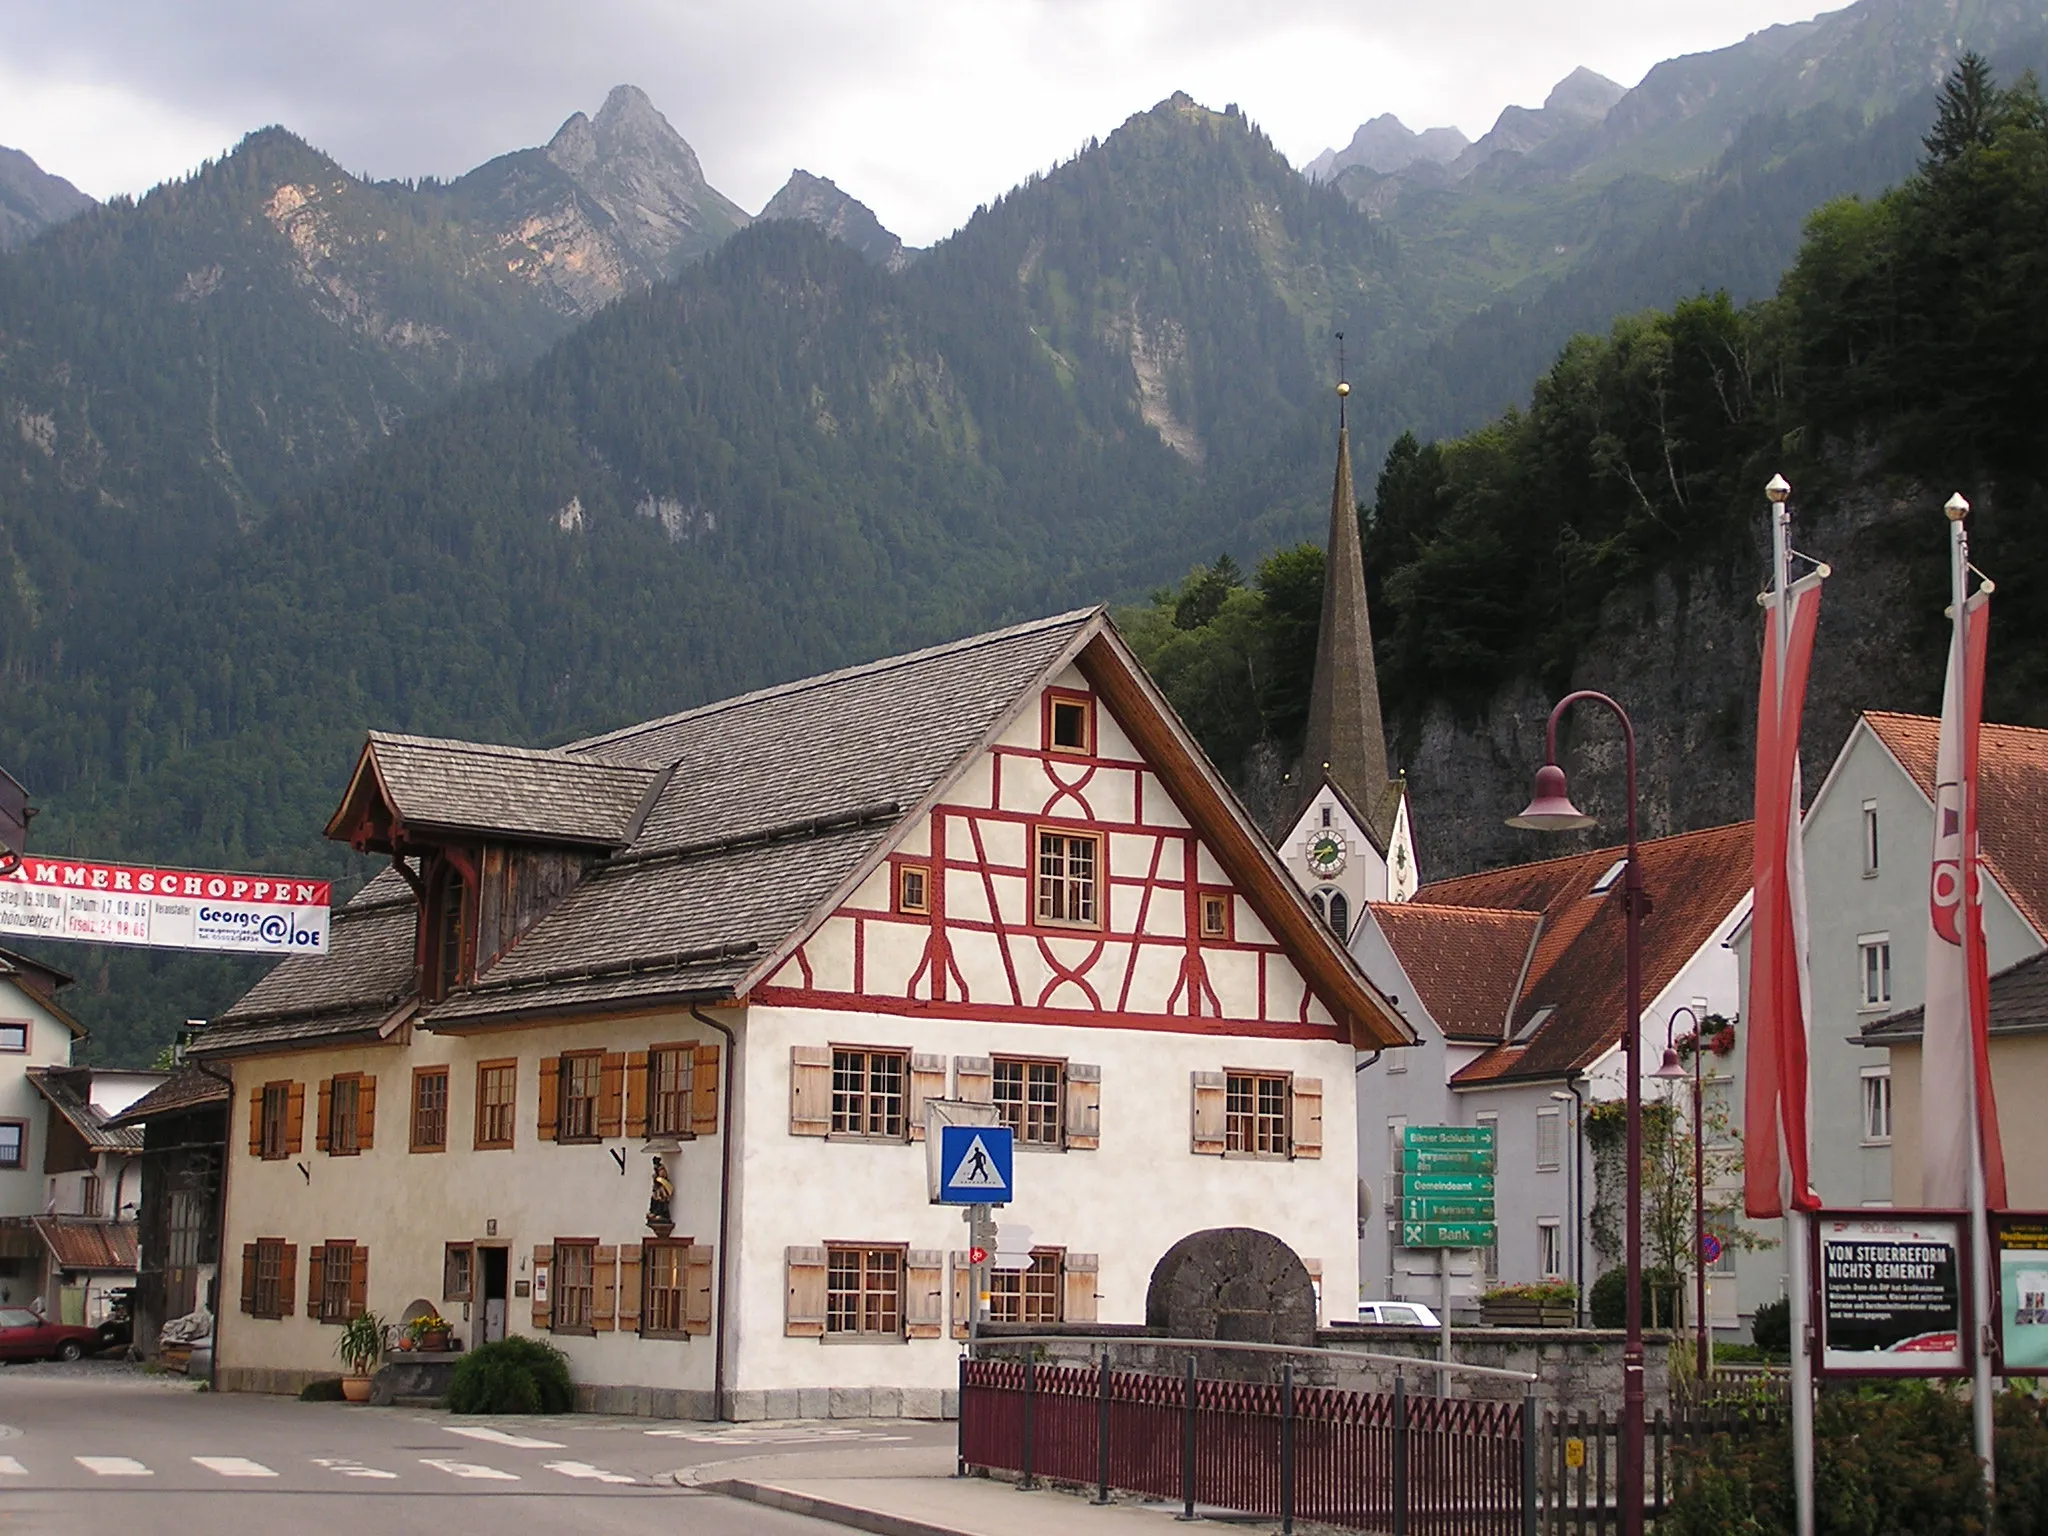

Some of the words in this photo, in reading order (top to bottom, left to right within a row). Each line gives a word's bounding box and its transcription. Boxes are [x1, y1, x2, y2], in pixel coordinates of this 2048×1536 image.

[200, 907, 260, 927] George
[1439, 1133, 1476, 1143] Schlucht
[1414, 1180, 1473, 1191] Gemeindeamt
[1438, 1227, 1471, 1241] Bank
[1828, 1246, 1853, 1261] VON
[1856, 1247, 1947, 1263] STEUERREFORM
[1828, 1263, 1872, 1279] NICHTS
[1875, 1264, 1936, 1280] BEMERKT?
